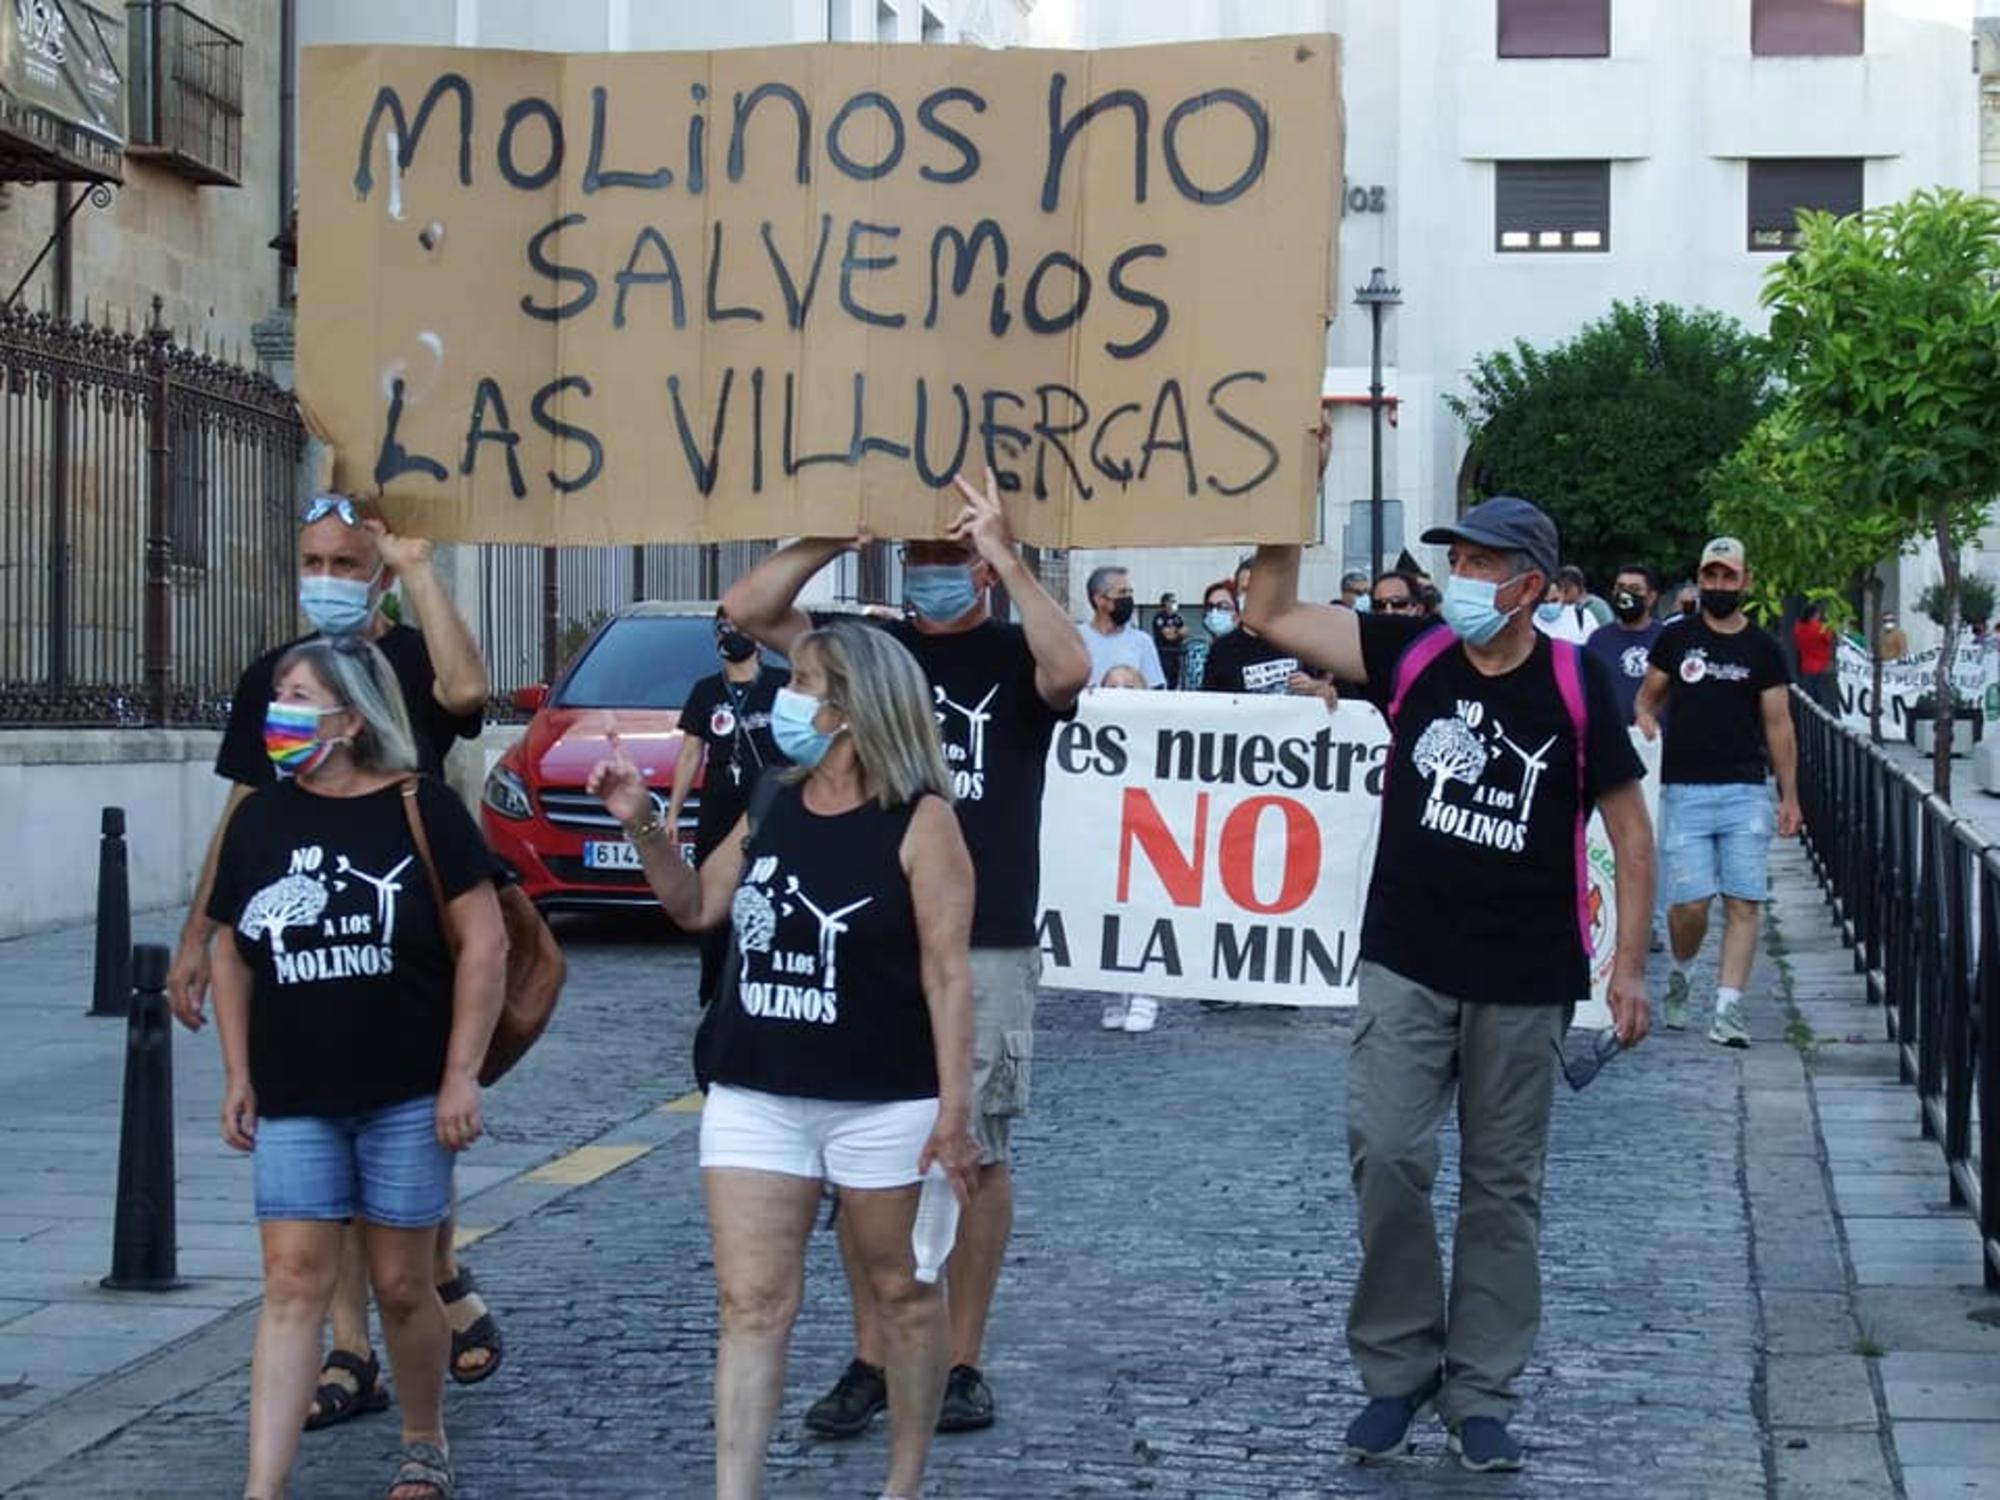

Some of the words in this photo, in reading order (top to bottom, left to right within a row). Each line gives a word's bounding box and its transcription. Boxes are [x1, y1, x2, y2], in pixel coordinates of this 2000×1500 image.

[520, 213, 1170, 359] SALVEMOS
[374, 377, 604, 497] LAS
[1056, 720, 1128, 776] es
[1155, 726, 1391, 796] nuestra
[1472, 785, 1485, 803] A
[1486, 787, 1516, 809] LOS
[1420, 798, 1528, 852] MOLINOS
[287, 846, 324, 874] NO
[596, 845, 644, 865] 614
[1116, 787, 1322, 914] NO
[323, 918, 336, 937] A
[340, 914, 372, 935] LOS
[1034, 909, 1072, 967] A
[1100, 914, 1183, 976] LA
[272, 944, 394, 984] MOLINOS
[772, 950, 784, 971] A
[786, 952, 815, 975] LOS
